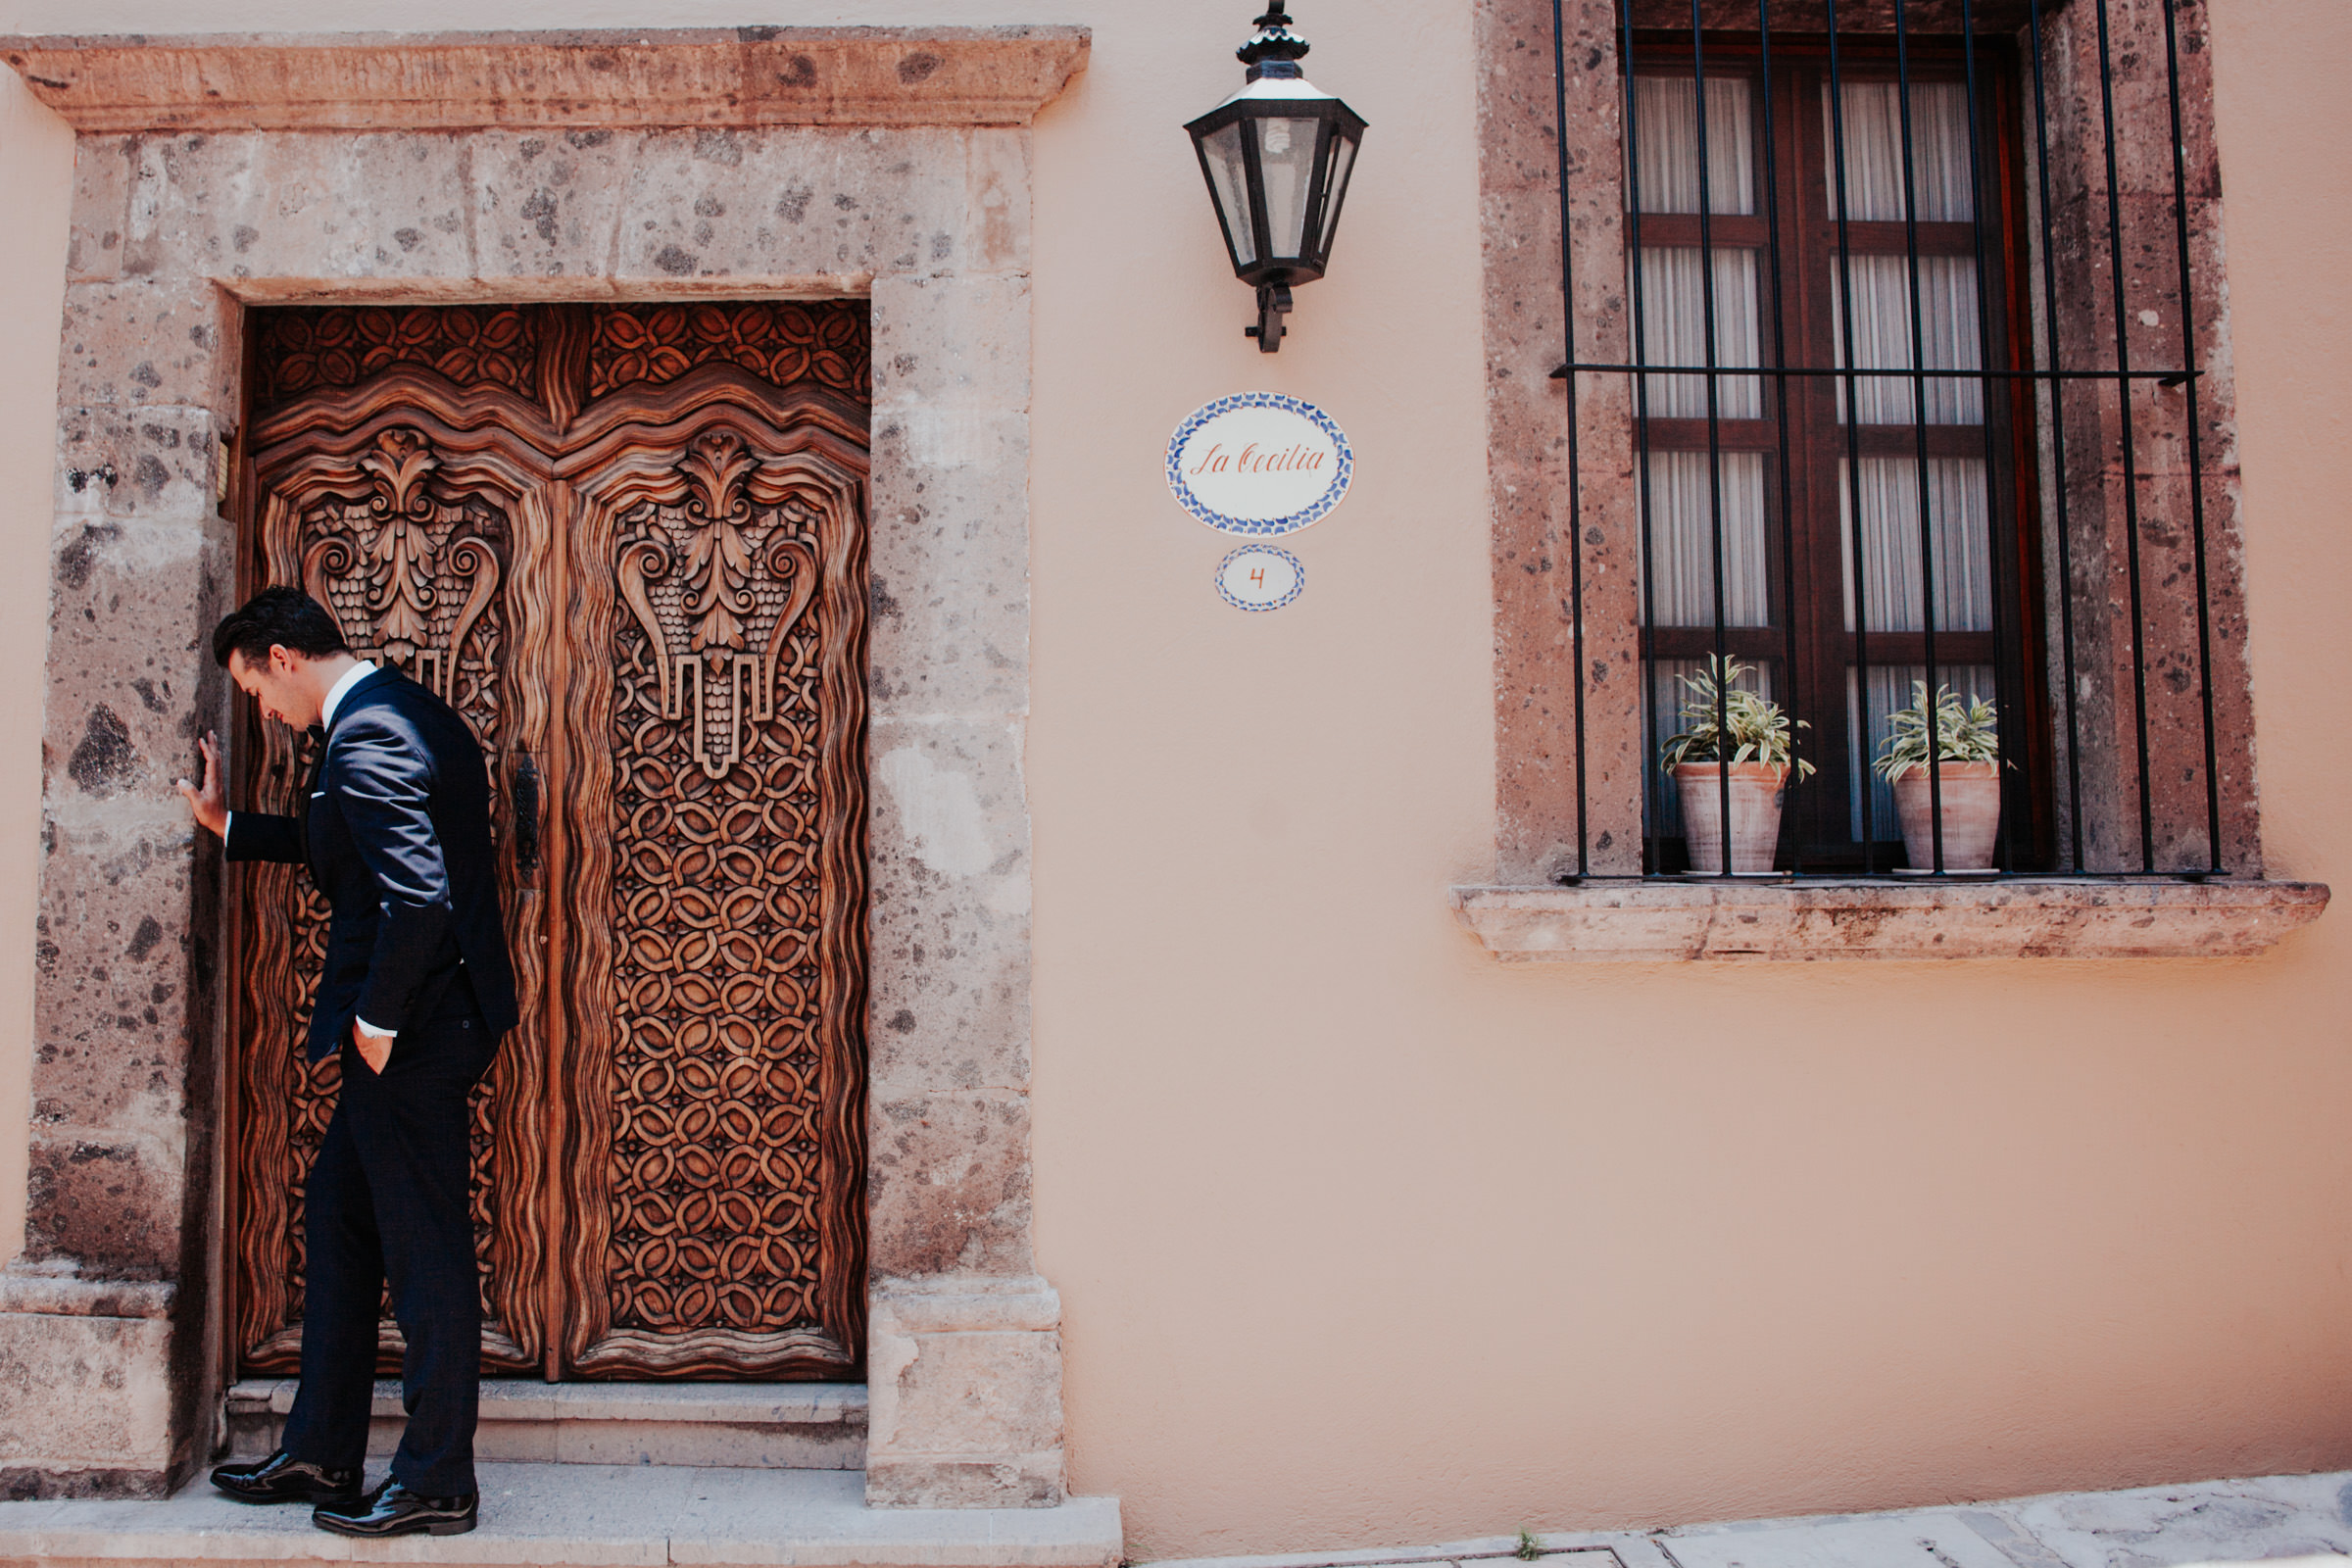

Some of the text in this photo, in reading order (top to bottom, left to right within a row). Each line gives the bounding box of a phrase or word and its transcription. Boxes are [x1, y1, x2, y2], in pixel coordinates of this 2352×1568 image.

[1190, 442, 1325, 475] La Cecilia
[1250, 567, 1265, 590] 4
